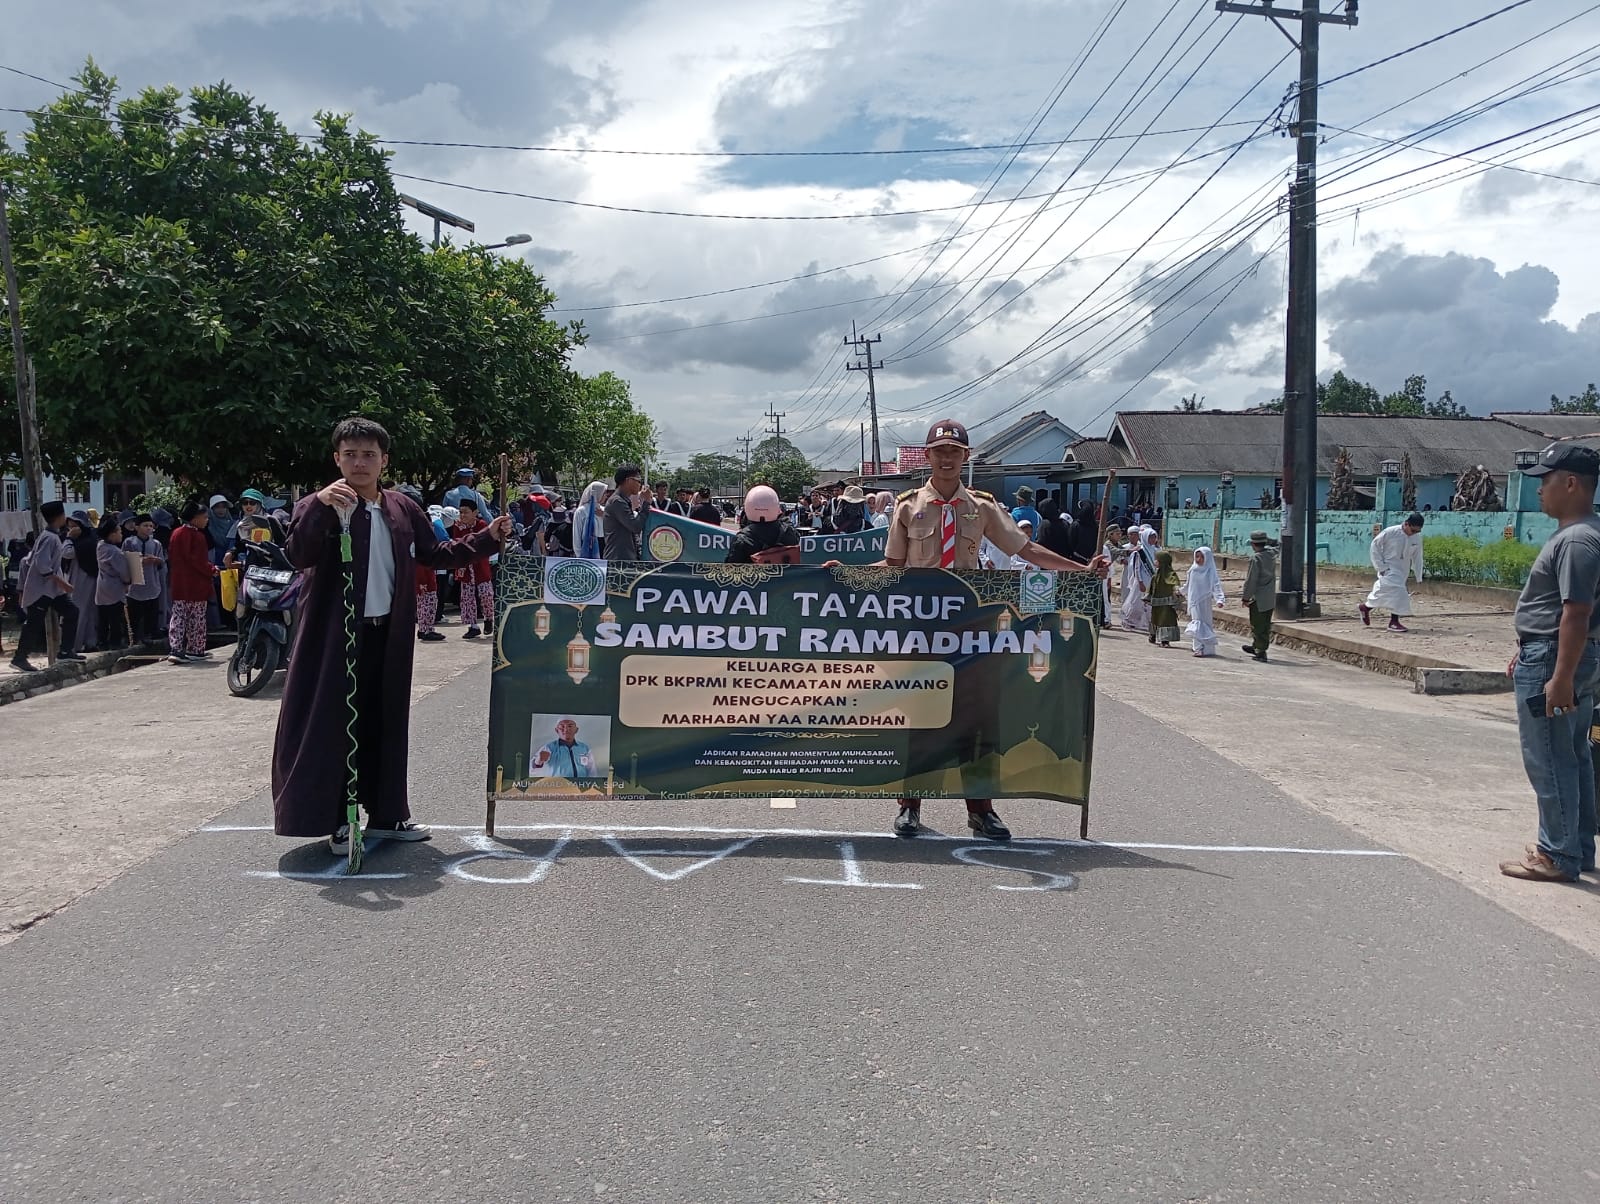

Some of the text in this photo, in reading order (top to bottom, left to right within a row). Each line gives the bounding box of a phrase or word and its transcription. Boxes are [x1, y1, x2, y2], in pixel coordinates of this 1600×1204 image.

[823, 536, 866, 553] GITA
[636, 587, 965, 620] PAWAI TA'ARUF
[594, 622, 1051, 654] SAMBUT RAMADHAN
[726, 660, 875, 674] KELUARGA BESAR
[625, 675, 949, 690] DPK BKPRMI KECAMATAN MERAWANG
[712, 695, 847, 707] MENGUCAPKAN
[661, 713, 906, 726] MARHABAN YAA RAMADHAN
[703, 790, 720, 799] 27
[723, 788, 773, 799] Februari
[778, 788, 810, 798] 2025
[841, 788, 857, 798] 28
[908, 788, 937, 798] 1446
